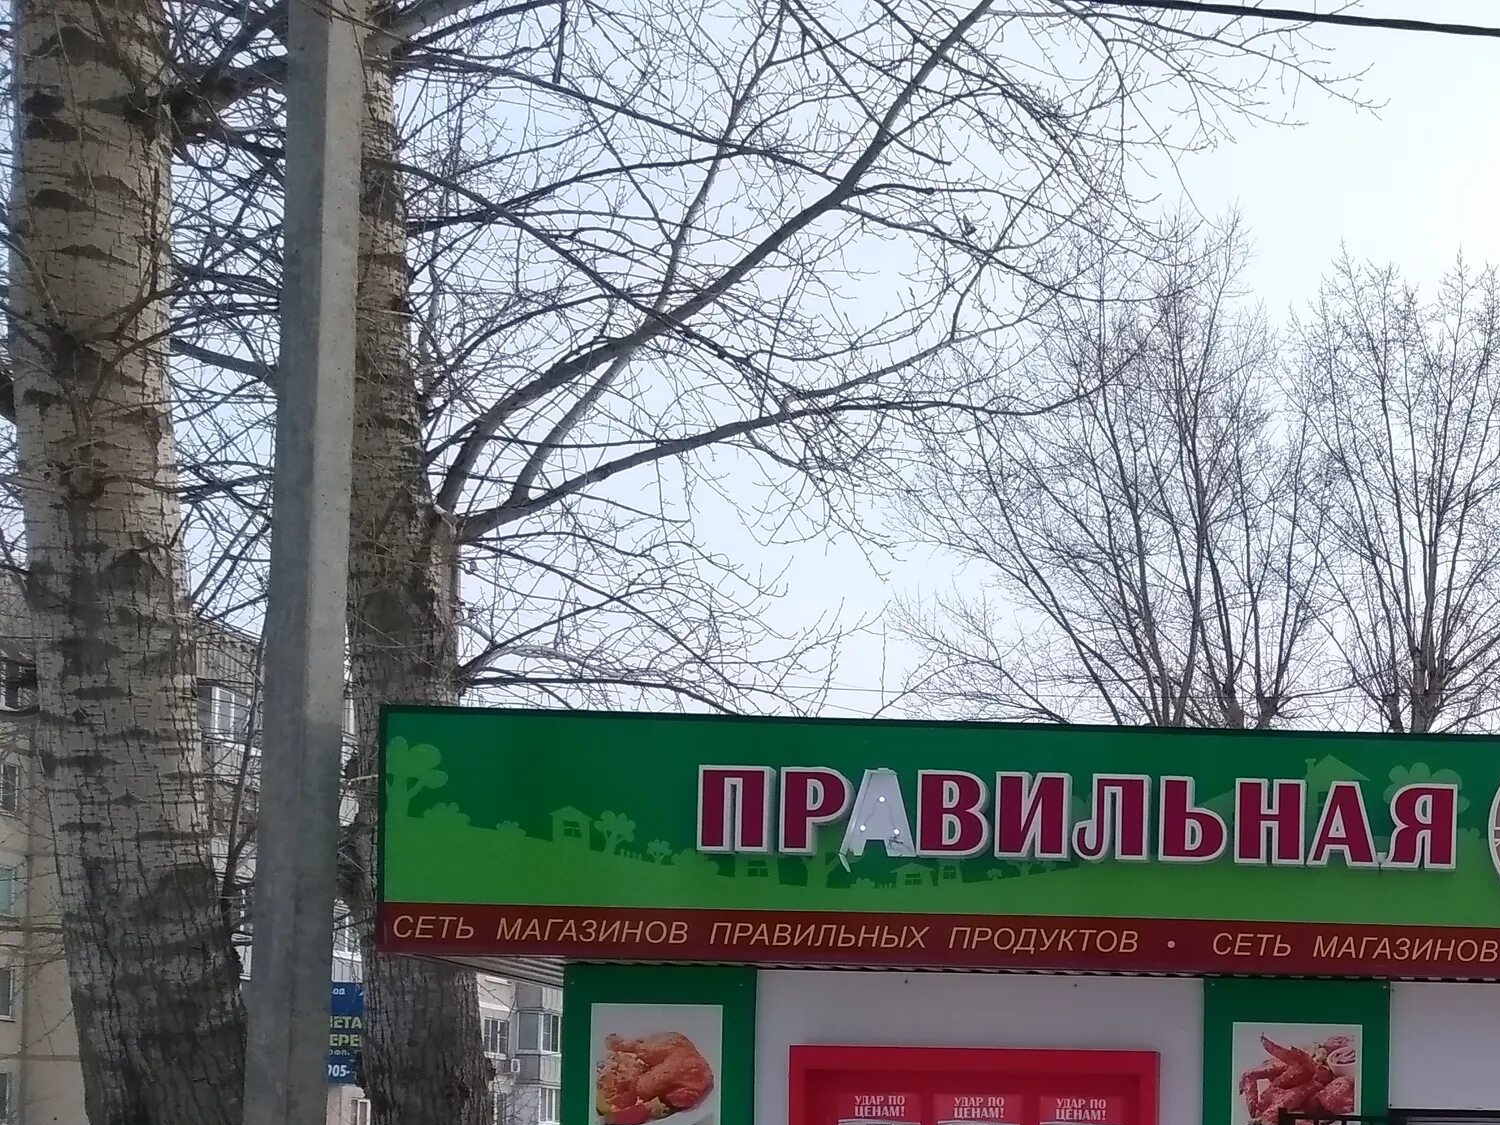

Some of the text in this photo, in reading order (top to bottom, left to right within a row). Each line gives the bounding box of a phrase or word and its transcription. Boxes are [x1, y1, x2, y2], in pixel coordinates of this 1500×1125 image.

[698, 763, 1459, 872] ПРАВИЛЬНАЯ
[392, 914, 475, 941] СЕТЬ
[496, 916, 689, 945] МАГАЗИНОВ
[709, 921, 930, 949] ПРАВИЛЬНЫХ
[947, 926, 1140, 955] ПРОДУКТОВ
[1212, 932, 1292, 958] СЕТЬ
[1312, 935, 1499, 963] МАГАЗИНОВ
[854, 1095, 905, 1106] УДАР ПО
[954, 1097, 1004, 1107] УДАР ПО
[1057, 1099, 1106, 1109] УДАР ПО
[854, 1105, 905, 1119] ЦЕНАМ!
[954, 1107, 1004, 1119] ЦЕНАМ!
[1056, 1109, 1105, 1121] ЦЕНАМ!
